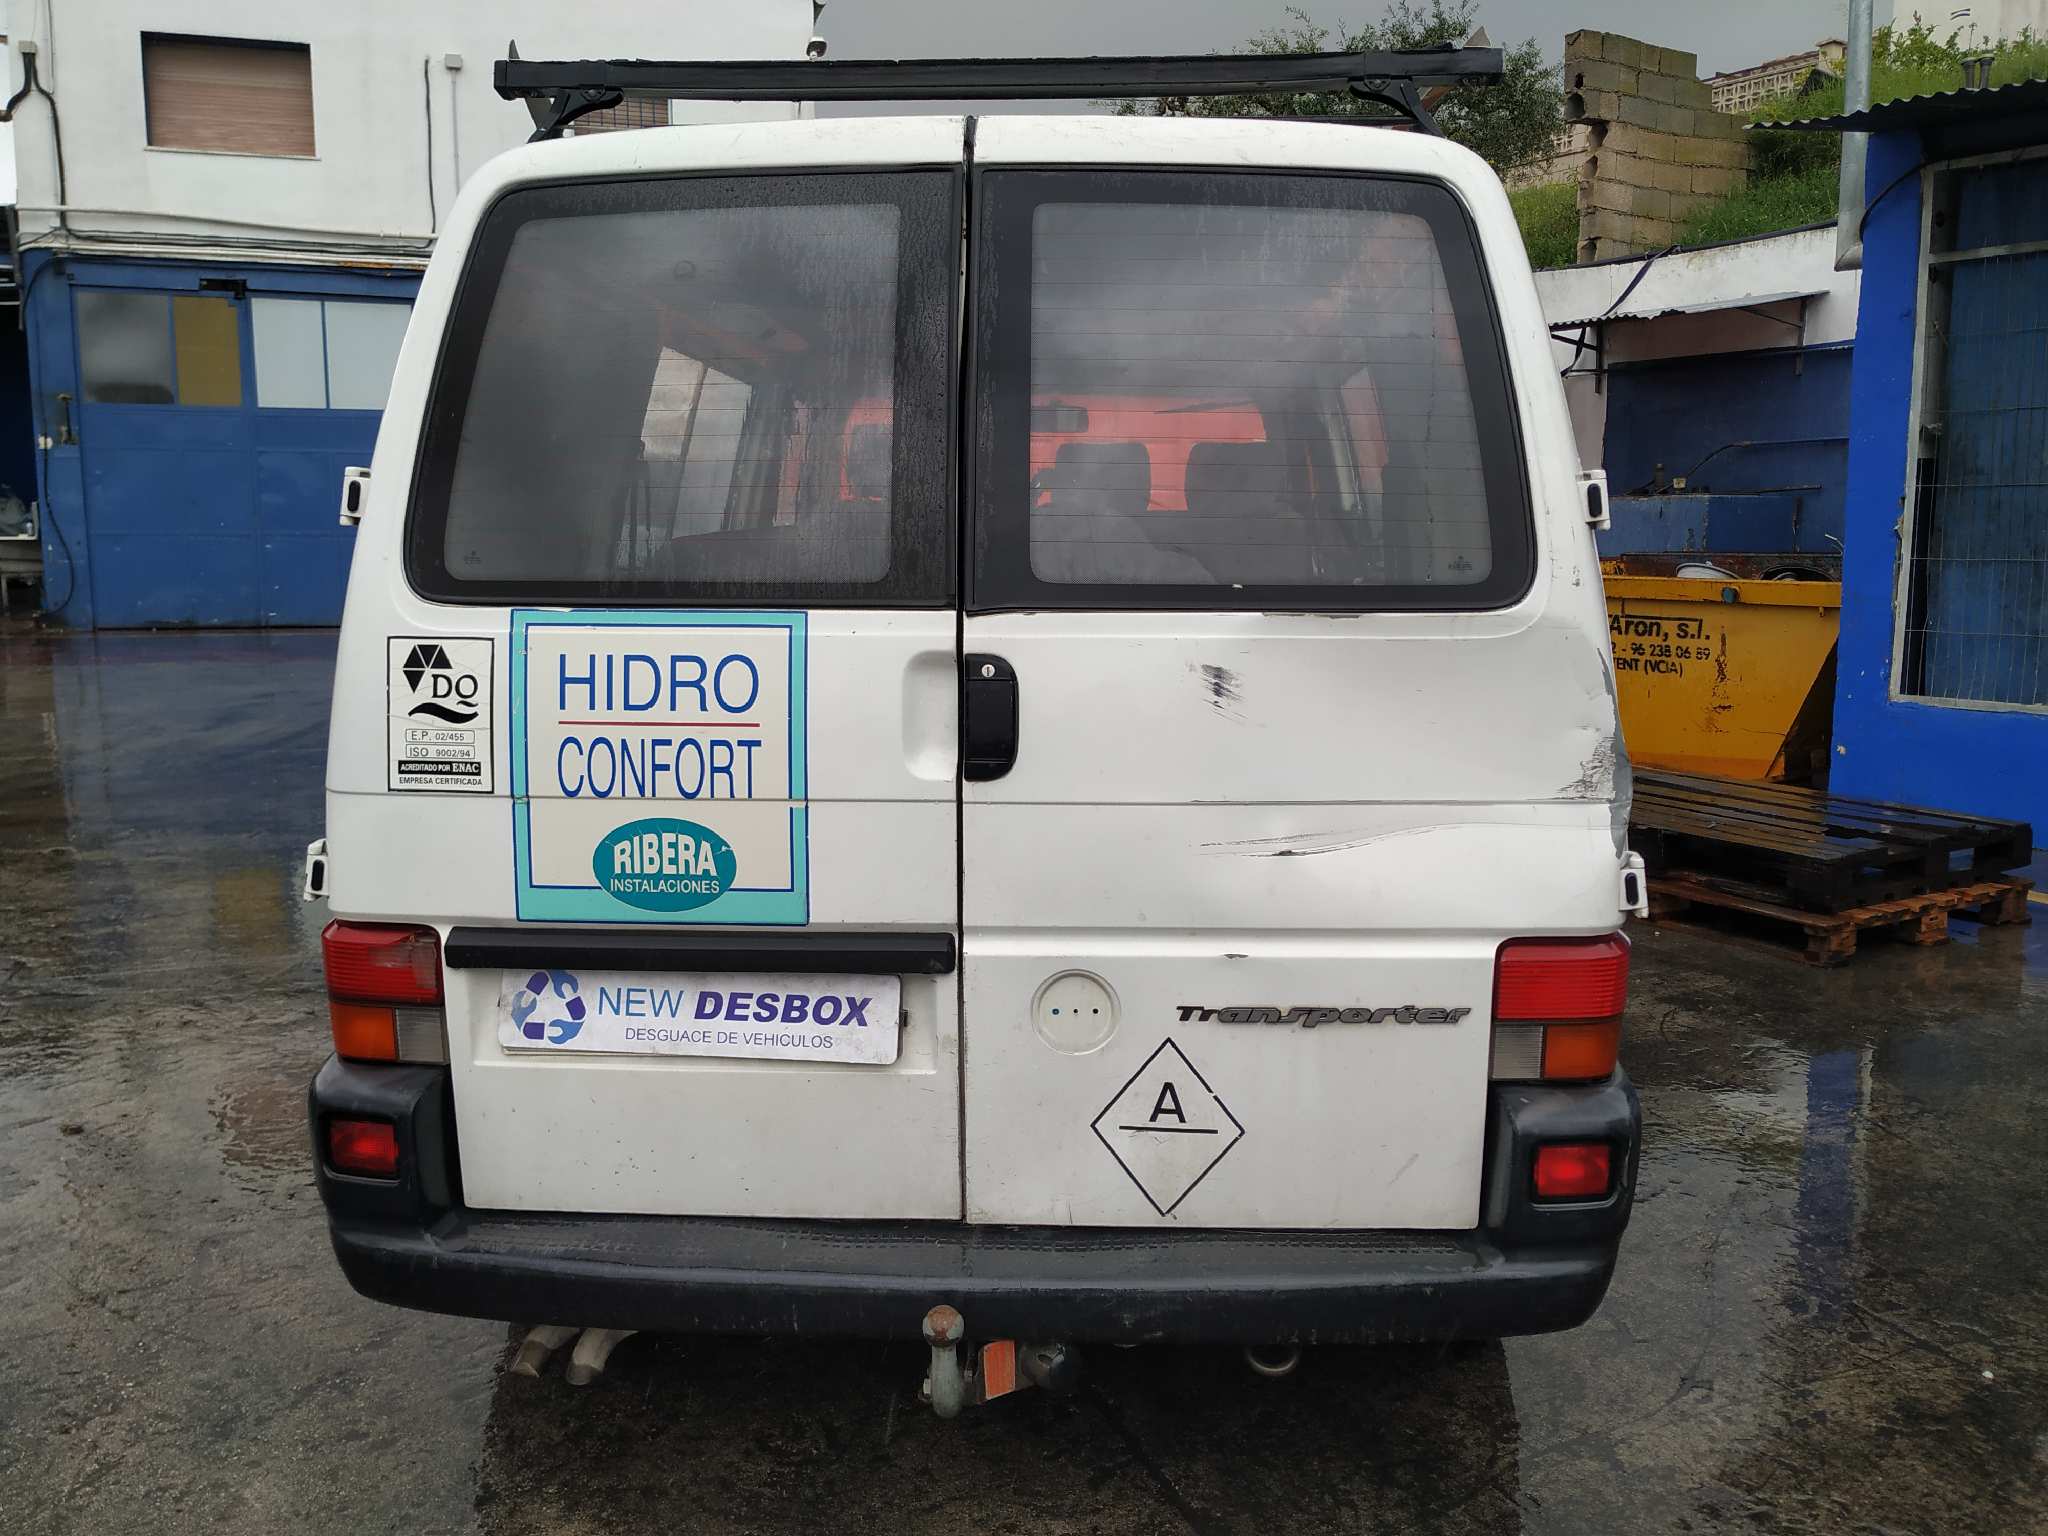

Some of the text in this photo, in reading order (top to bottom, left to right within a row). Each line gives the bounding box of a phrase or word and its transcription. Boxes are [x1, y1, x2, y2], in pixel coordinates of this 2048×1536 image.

[1649, 643, 1672, 658] 238
[432, 673, 479, 708] DQ
[559, 653, 760, 714] HIDRO
[411, 730, 465, 741] E.P. 02/455
[409, 747, 471, 758] ISO 9002/94
[400, 763, 480, 773] ACREDITADO POR ENAC
[557, 736, 762, 800] CONFORT
[399, 776, 483, 786] EMPRESA CERTIFICADA
[614, 832, 718, 877] RIBERA
[610, 878, 720, 894] INSTALACIONES
[598, 986, 873, 1027] NEW DESBOX
[1176, 1005, 1472, 1028] Transporter
[625, 1027, 834, 1049] DESGUACE DE VEHICULOS
[1149, 1082, 1186, 1123] A
